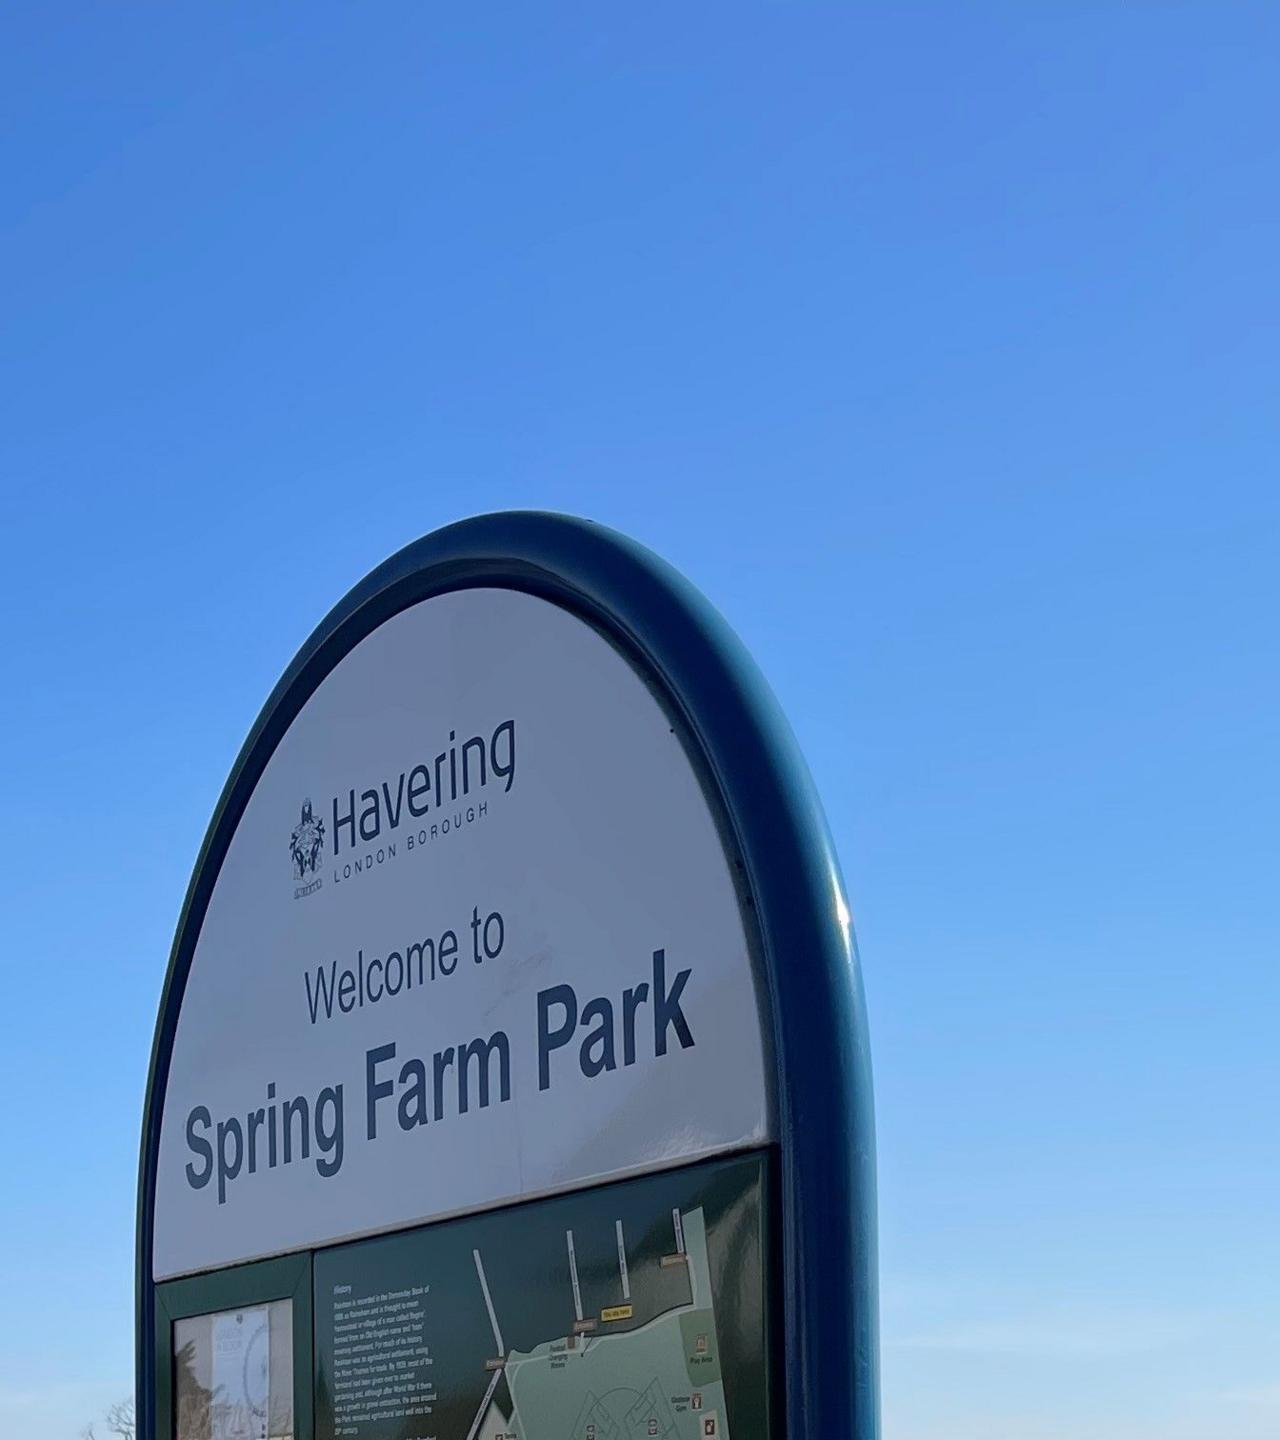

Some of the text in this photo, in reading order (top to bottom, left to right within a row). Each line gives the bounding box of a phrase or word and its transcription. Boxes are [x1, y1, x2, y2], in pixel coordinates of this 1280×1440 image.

[332, 718, 517, 856] Havering
[333, 800, 488, 883] LONDON BOROUGH
[305, 906, 505, 1025] Welcome to
[184, 948, 695, 1204] Spring Farm Park
